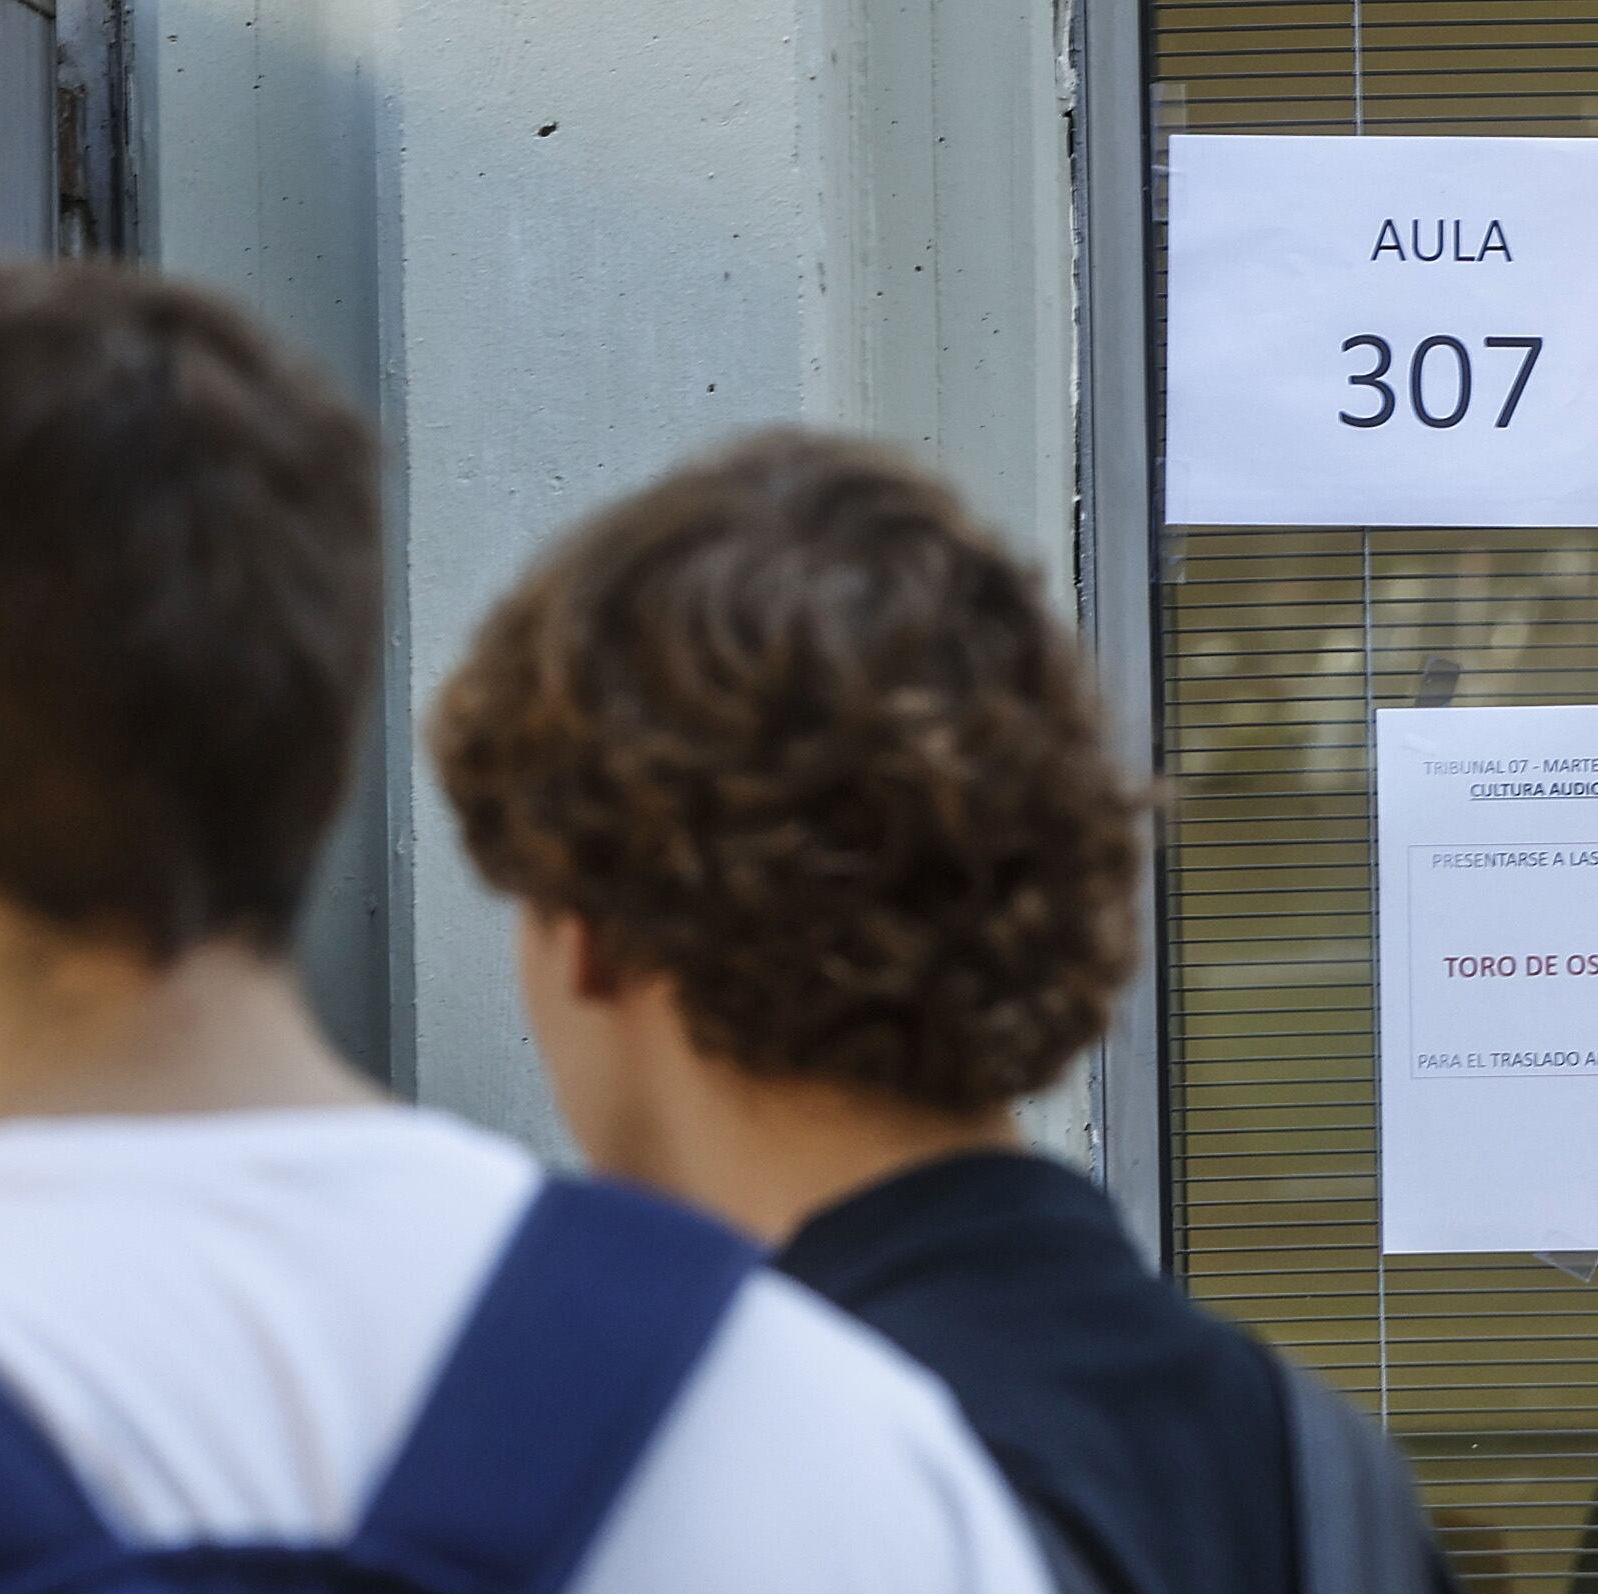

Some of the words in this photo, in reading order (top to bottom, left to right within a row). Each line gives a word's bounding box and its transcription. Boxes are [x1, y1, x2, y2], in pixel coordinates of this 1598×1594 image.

[1372, 218, 1512, 262] AULA
[1339, 334, 1543, 428] 307
[1424, 760, 1505, 776] TRIBUNAL
[1509, 760, 1527, 774] 07
[1470, 782, 1545, 798] CULTURA
[1433, 852, 1547, 868] PRESENTARSE
[1553, 852, 1565, 866] A
[1571, 851, 1598, 866] LAS
[1444, 956, 1516, 978] TORO
[1526, 955, 1557, 976] DE
[1418, 1054, 1460, 1069] PARA
[1468, 1053, 1485, 1068] EL
[1491, 1052, 1580, 1067] TRASLADO
